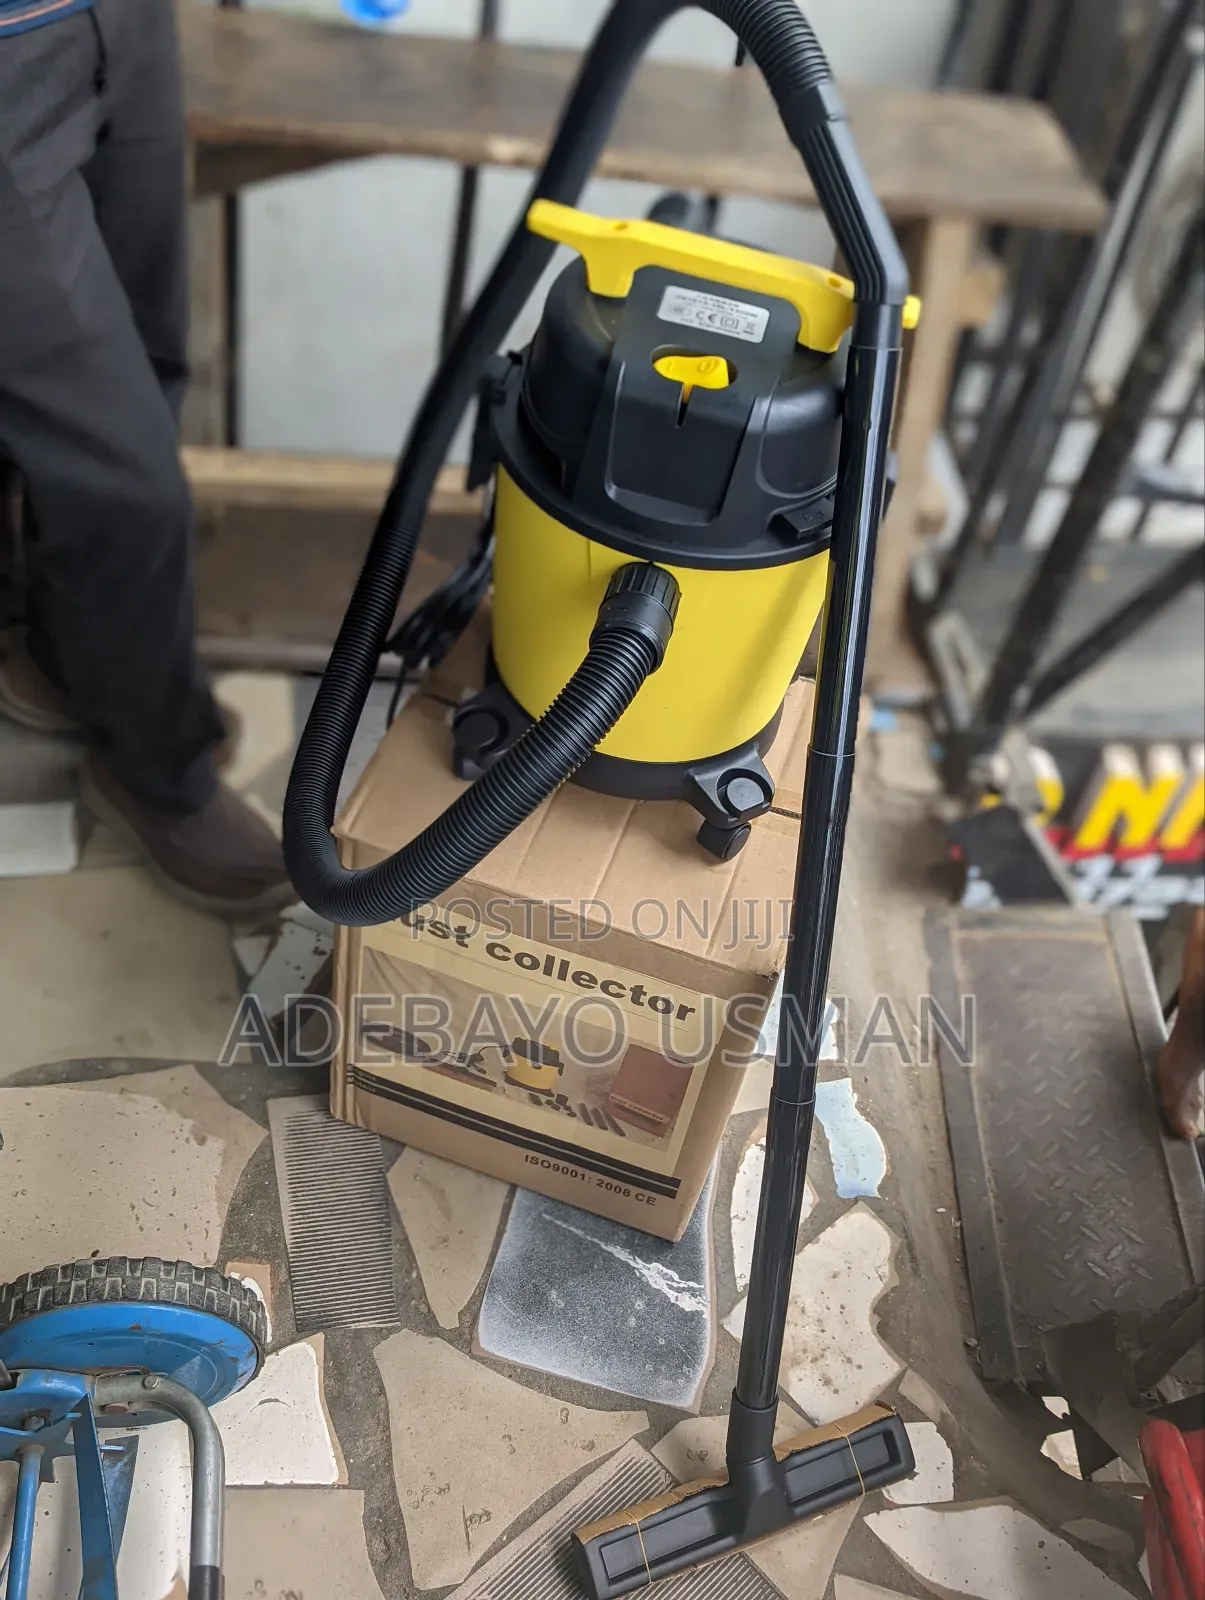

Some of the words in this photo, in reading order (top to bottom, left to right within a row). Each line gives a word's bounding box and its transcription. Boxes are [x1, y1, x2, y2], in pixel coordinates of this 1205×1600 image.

[391, 910, 470, 949] ust
[485, 942, 696, 1022] collector
[525, 1154, 591, 1183] ISO9001:
[596, 1178, 631, 1197] 2008
[635, 1192, 657, 1206] CE
